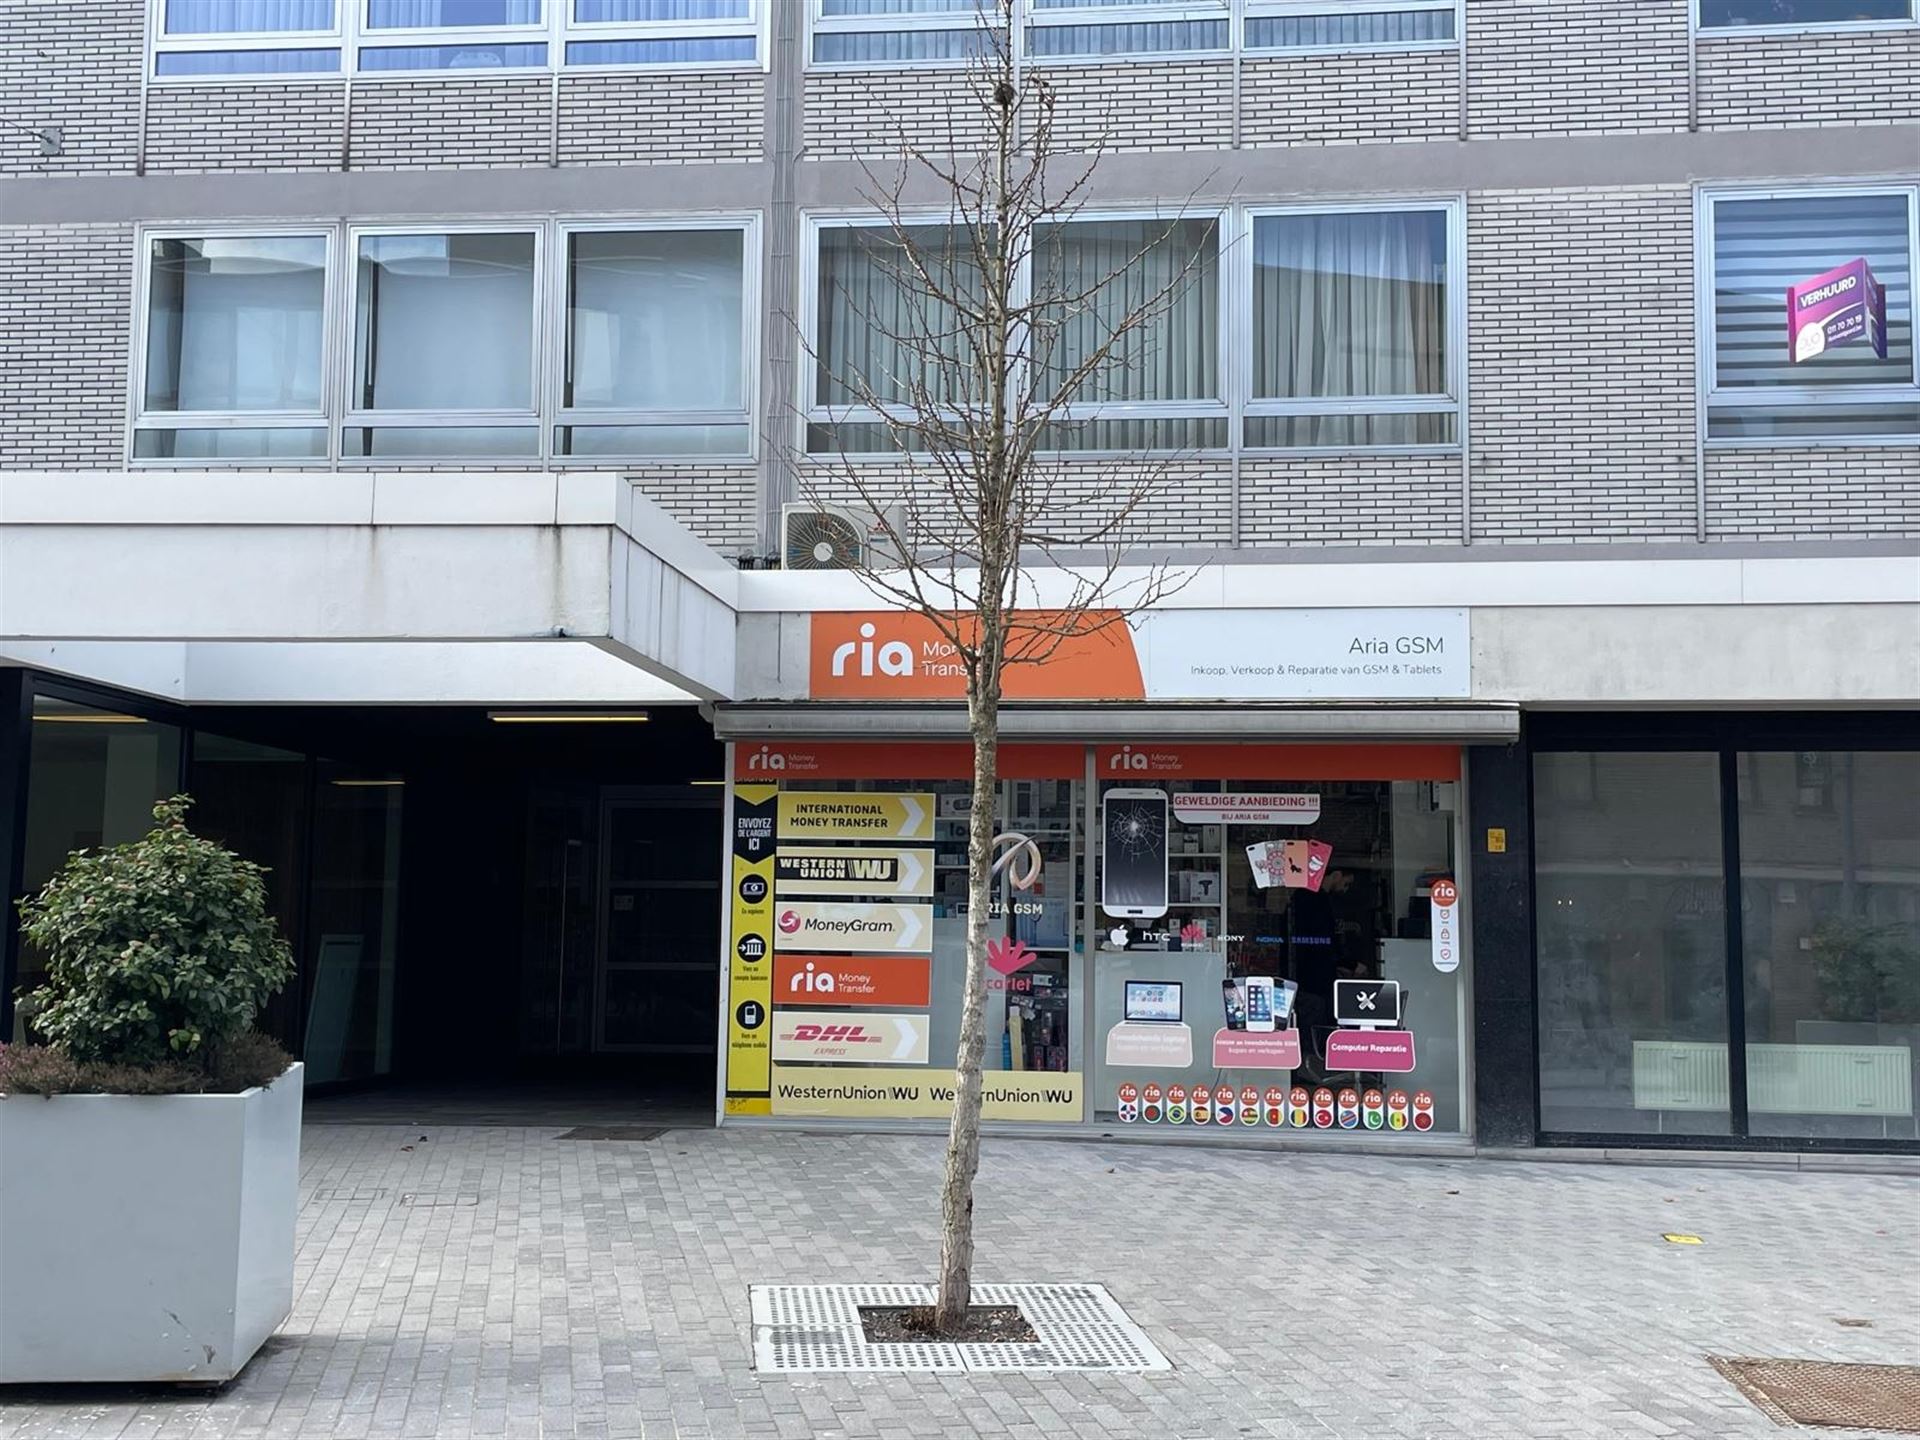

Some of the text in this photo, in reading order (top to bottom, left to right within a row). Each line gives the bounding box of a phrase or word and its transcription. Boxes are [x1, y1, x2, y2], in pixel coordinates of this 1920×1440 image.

[1800, 276, 1856, 307] VERHUURD
[832, 623, 913, 676] ria
[1349, 637, 1444, 654] Aria GSM
[1231, 665, 1274, 676] Verkoop
[1277, 665, 1285, 675] &
[1288, 665, 1338, 676] Reparatie
[1341, 667, 1360, 675] van
[1363, 665, 1389, 675] GSM
[1392, 665, 1400, 675] &
[1403, 665, 1442, 675] Tablets
[749, 746, 785, 770] ria
[789, 754, 815, 762] Money
[1110, 745, 1148, 770] ria
[1151, 753, 1179, 762] Money
[788, 762, 819, 770] Transfer
[1151, 762, 1183, 770] Transfer
[1174, 796, 1319, 807] GEWELDIGE AANBIEDING !!!
[796, 804, 883, 815] INTERNATIONAL
[1221, 813, 1270, 821] BIJ ARIA GSM
[738, 817, 772, 829] ENVOYEZ
[790, 818, 888, 828] MONEY TRANSFER
[737, 829, 746, 837] DE
[748, 838, 760, 851] ICI
[780, 858, 846, 869] WESTERN
[800, 868, 846, 878] UNION
[852, 860, 891, 880] WU
[1433, 884, 1455, 897] ria
[1013, 903, 1043, 915] GSM
[791, 962, 835, 992] ria
[838, 973, 871, 984] Money
[838, 984, 876, 994] Transfer
[983, 978, 1032, 991] carlet
[793, 1025, 869, 1043] DHL
[1331, 1043, 1407, 1053] Computer Reparatie
[777, 1085, 887, 1100] WesternUnion
[892, 1087, 919, 1100] WU
[1046, 1089, 1073, 1103] WU
[1121, 1085, 1136, 1096] ria
[1144, 1086, 1160, 1097] ria
[1169, 1086, 1184, 1097] ria
[1193, 1087, 1208, 1098] ria
[1217, 1088, 1233, 1098] ria
[1242, 1088, 1257, 1099] ria
[1266, 1089, 1282, 1100] ria
[1290, 1090, 1307, 1101] ria
[1315, 1090, 1331, 1101] ria
[1340, 1091, 1356, 1102] ria
[1365, 1092, 1381, 1103] ria
[1390, 1093, 1406, 1104] ria
[1415, 1093, 1431, 1104] ria
